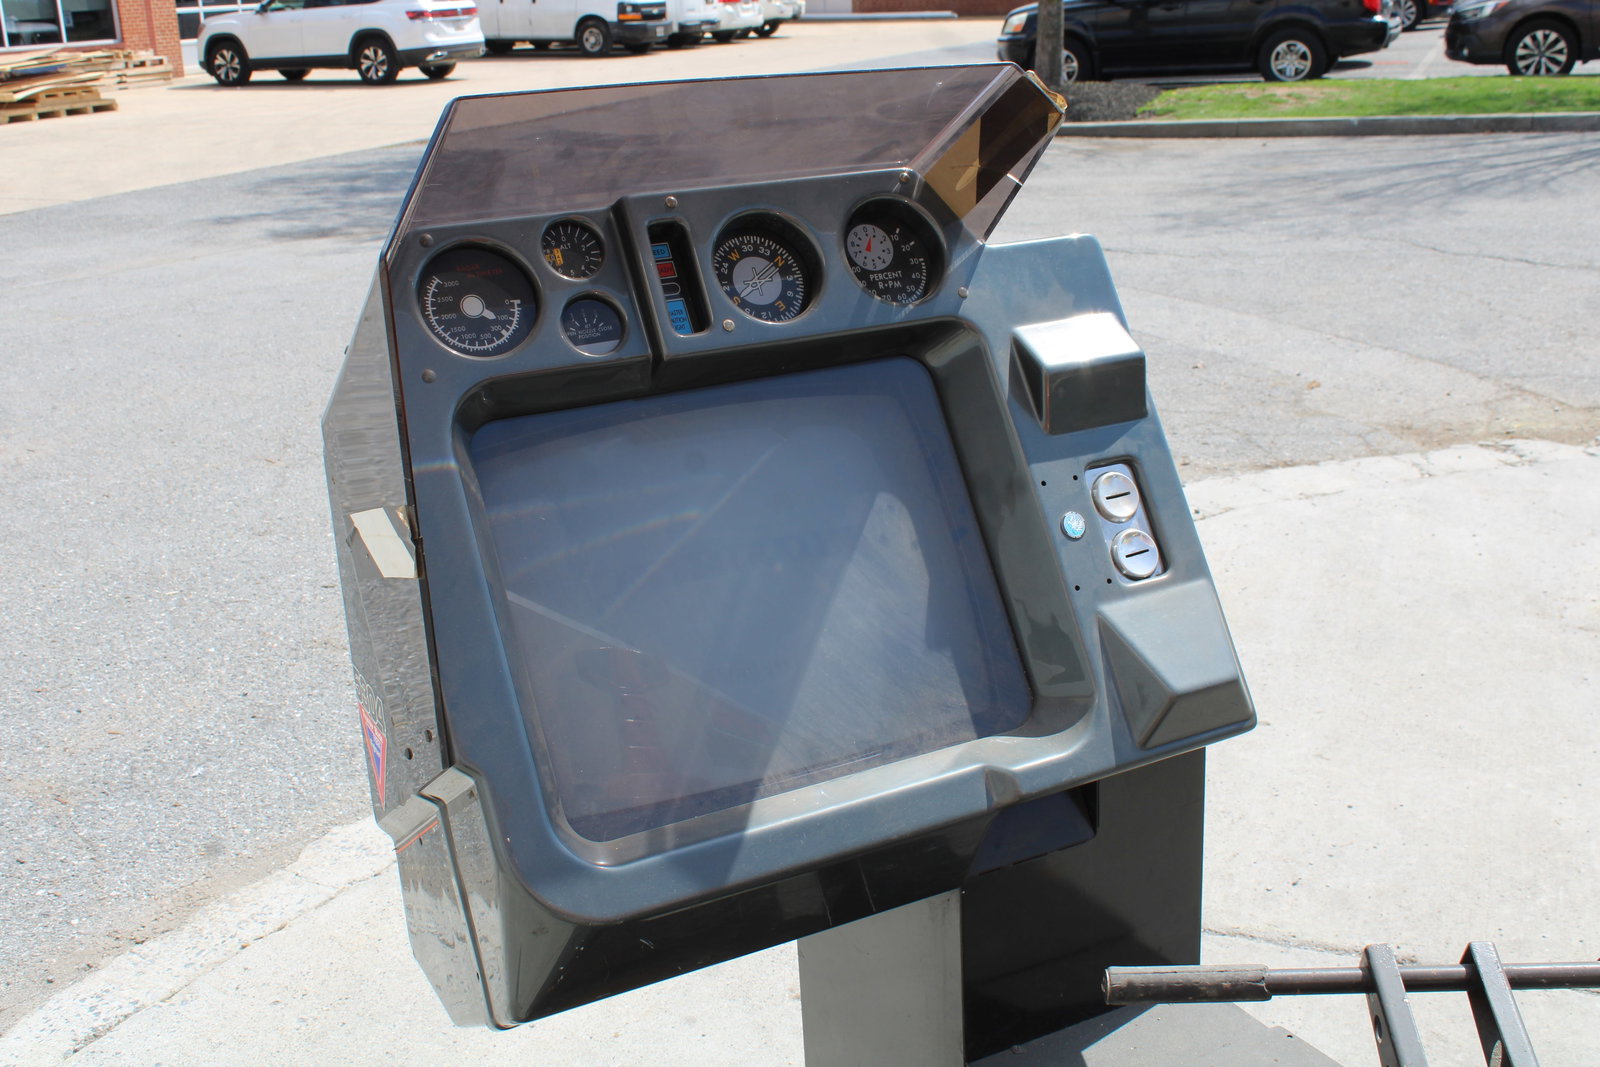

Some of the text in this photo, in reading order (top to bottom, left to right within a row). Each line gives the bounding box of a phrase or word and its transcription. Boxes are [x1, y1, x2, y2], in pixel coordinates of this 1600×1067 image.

[727, 249, 740, 261] W
[758, 246, 771, 256] 33
[774, 256, 785, 266] N
[721, 262, 729, 274] 24
[869, 270, 902, 281] PERCENT
[733, 296, 741, 305] S
[774, 301, 786, 311] E
